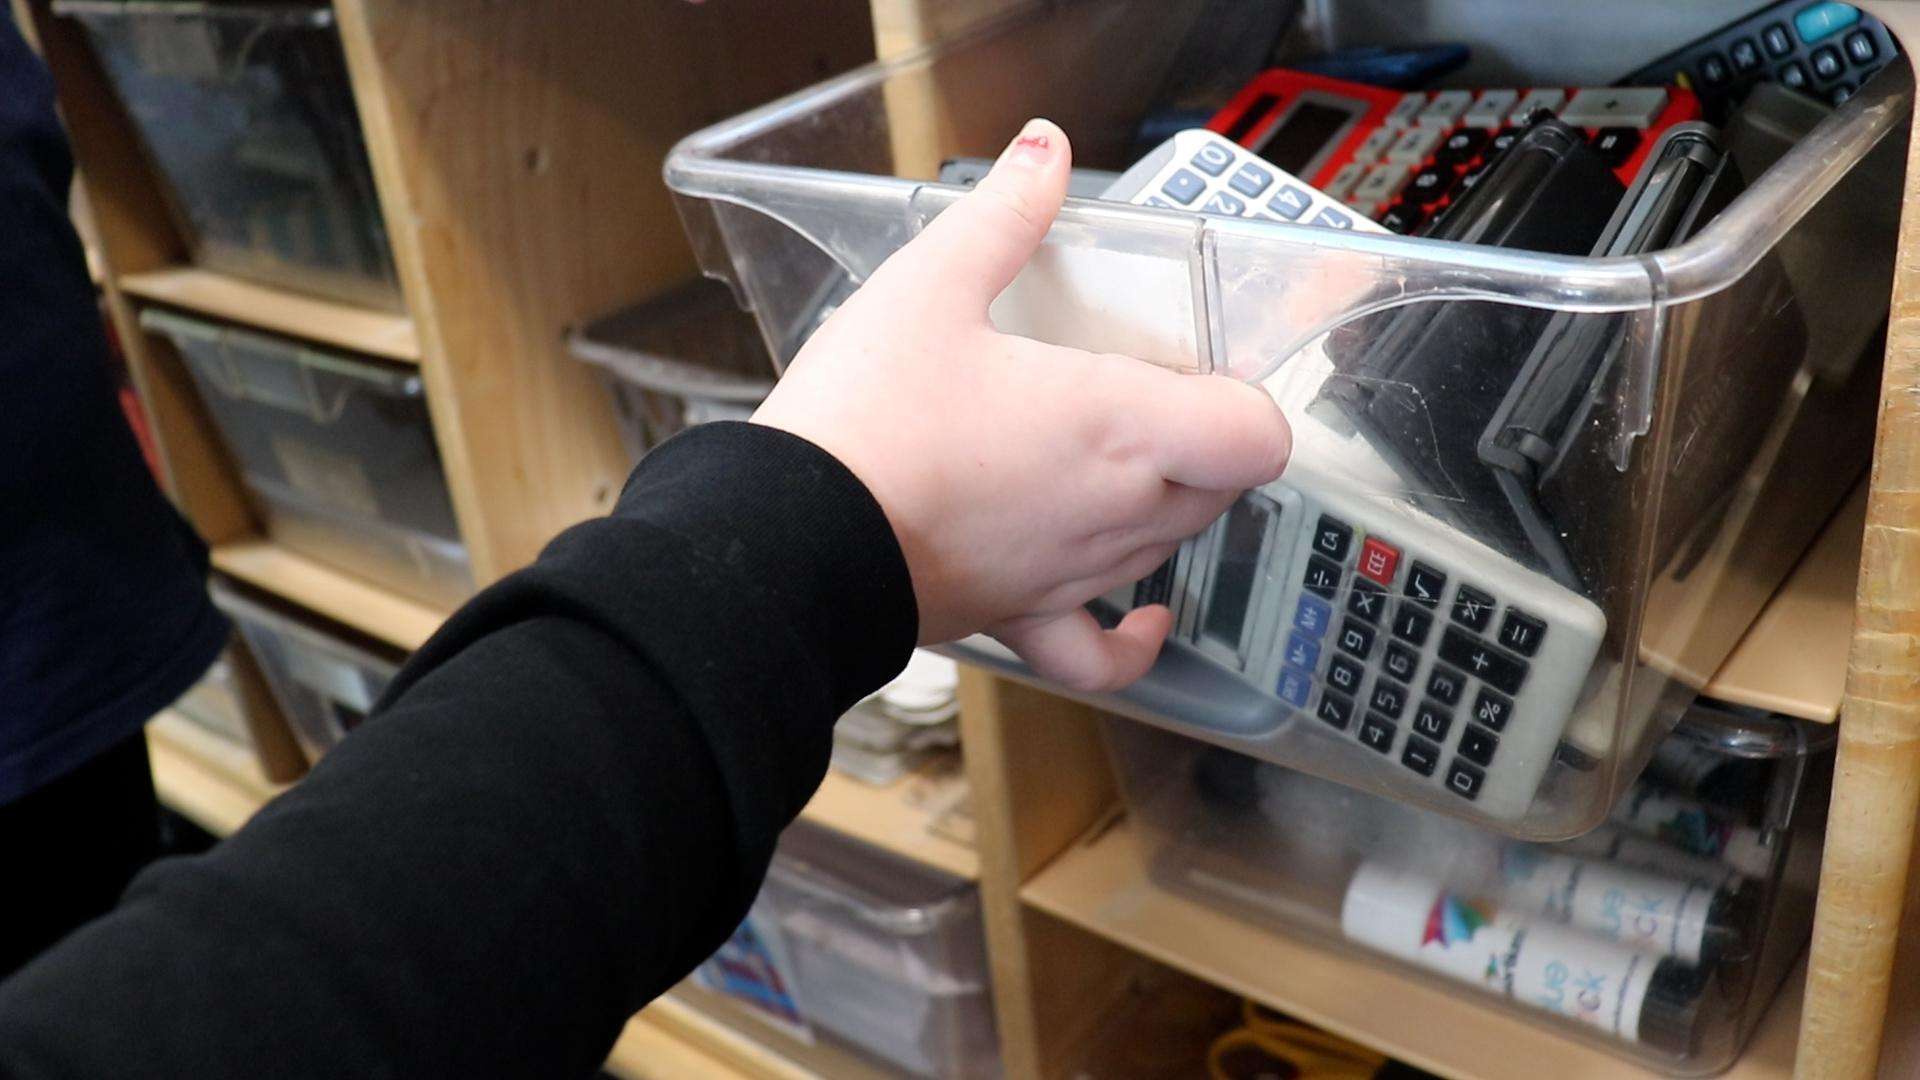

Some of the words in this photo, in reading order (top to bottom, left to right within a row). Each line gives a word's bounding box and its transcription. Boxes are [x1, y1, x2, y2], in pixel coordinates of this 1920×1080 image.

[1201, 148, 1228, 165] 0
[1239, 170, 1263, 185] 1
[1277, 190, 1302, 208] 4
[1345, 630, 1363, 650] 9
[1389, 654, 1408, 674] 6
[1334, 667, 1351, 686] 8
[1434, 678, 1453, 696] 3
[1324, 701, 1340, 719] 7
[1377, 692, 1397, 710] 5
[1421, 713, 1440, 733] 2
[1369, 725, 1385, 743] 4
[1411, 753, 1427, 763] 1
[1454, 772, 1473, 791] 0
